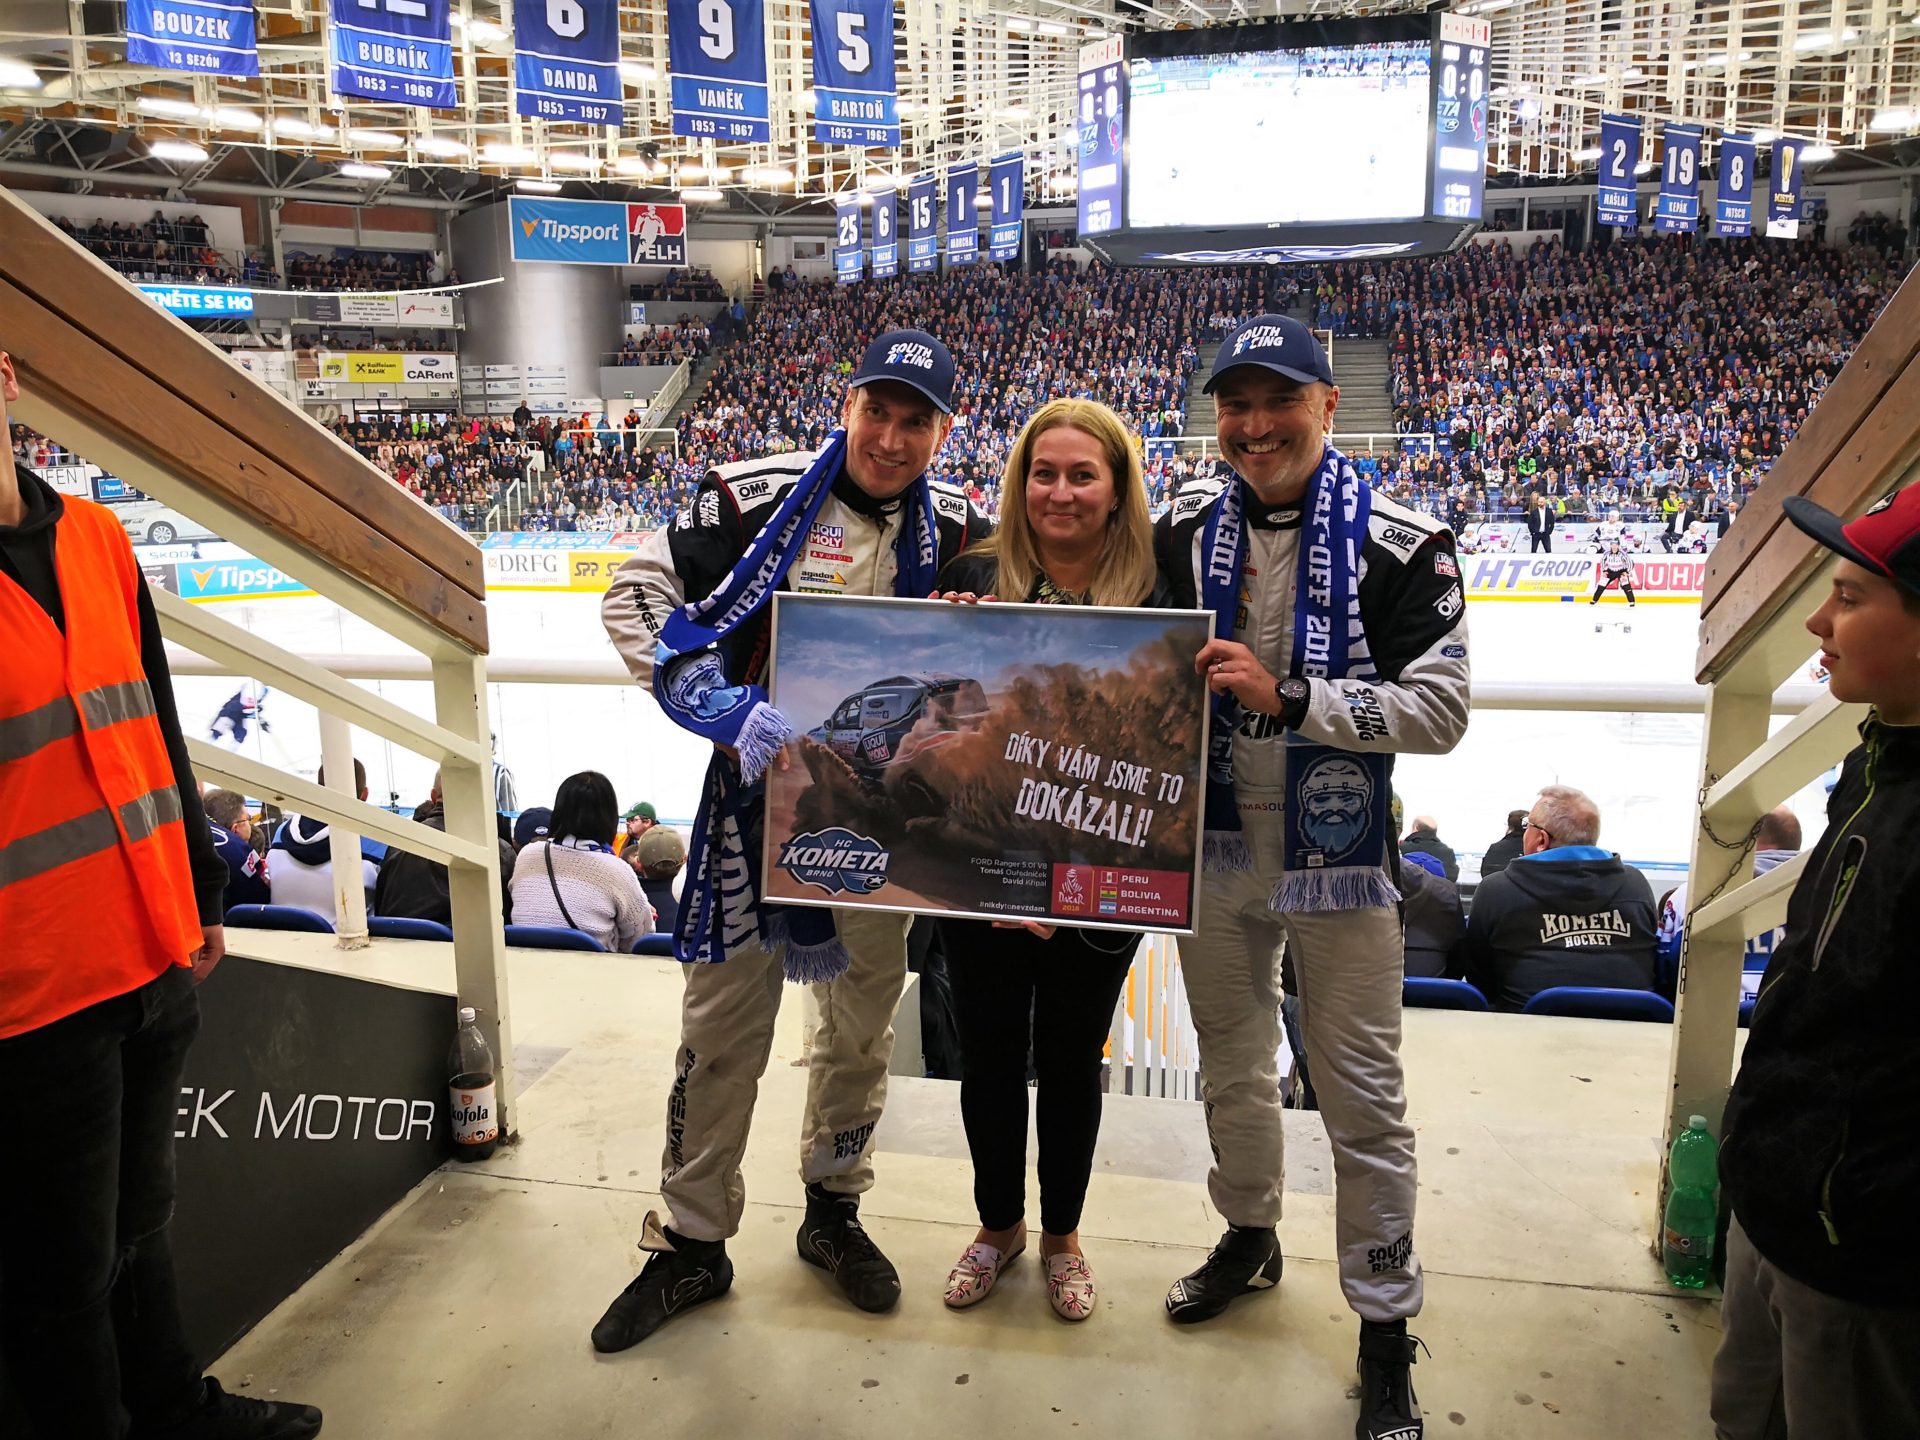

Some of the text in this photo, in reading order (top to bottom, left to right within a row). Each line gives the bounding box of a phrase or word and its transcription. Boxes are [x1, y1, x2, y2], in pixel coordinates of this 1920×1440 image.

[153, 10, 231, 41] BOUZEK
[698, 0, 734, 60] 9
[836, 11, 871, 73] 5
[169, 51, 220, 69] 13 SEZÓN
[358, 42, 430, 71] BUBNÍK
[357, 75, 387, 92] 1953
[404, 82, 434, 99] 1966
[543, 67, 598, 92] DANDA
[698, 84, 744, 111] VANĚK
[536, 100, 565, 115] 1953
[580, 104, 608, 120] 1967
[831, 98, 884, 120] BARTOŇ
[690, 119, 717, 134] 1953
[729, 122, 754, 137] 1967
[830, 126, 853, 139] 1953
[864, 128, 888, 142] 1962
[1611, 138, 1627, 178] 2
[1667, 146, 1694, 185] 19
[1730, 155, 1744, 191] 8
[956, 186, 965, 221] 1
[1001, 176, 1010, 214] 1
[878, 206, 890, 237] 6
[911, 195, 931, 230] 15
[542, 219, 619, 244] Tipsport
[839, 214, 858, 247] 25
[205, 294, 224, 309] SE
[1236, 325, 1282, 343] SOUTH
[888, 342, 933, 359] SOUTH
[407, 370, 455, 380] CARent
[738, 481, 770, 498] OMP
[939, 498, 965, 513] OMP
[1176, 498, 1201, 512] OMP
[810, 523, 842, 538] LIQUI
[810, 533, 842, 548] MOLY
[1381, 527, 1418, 549] OMP
[499, 553, 558, 573] DRFG
[1471, 559, 1531, 589] HT
[1531, 560, 1592, 577] GROUP
[801, 570, 835, 580] agados
[1437, 586, 1461, 617] OMP
[1356, 687, 1390, 736] SOUTH
[1004, 730, 1184, 805] DÍKY VÁM JSME TO
[1014, 777, 1154, 848] DOKÁZALI!
[834, 838, 853, 848] HC
[781, 846, 889, 872] KOMETA
[971, 857, 993, 866] FORD
[994, 859, 1020, 869] Ranger
[805, 869, 834, 879] BRNO
[980, 866, 1004, 875] Tomáš
[1002, 877, 1024, 886] David
[1121, 874, 1149, 885] PERU
[1058, 891, 1086, 906] DAKAR
[1120, 889, 1161, 901] BOLIVIA
[1062, 904, 1080, 912] 2018
[1119, 904, 1179, 917] ARGENTINA
[1542, 909, 1628, 938] KOMETA
[1565, 933, 1612, 949] HOCKEY
[254, 1091, 435, 1141] MOTOR
[834, 1121, 875, 1146] SOUTH
